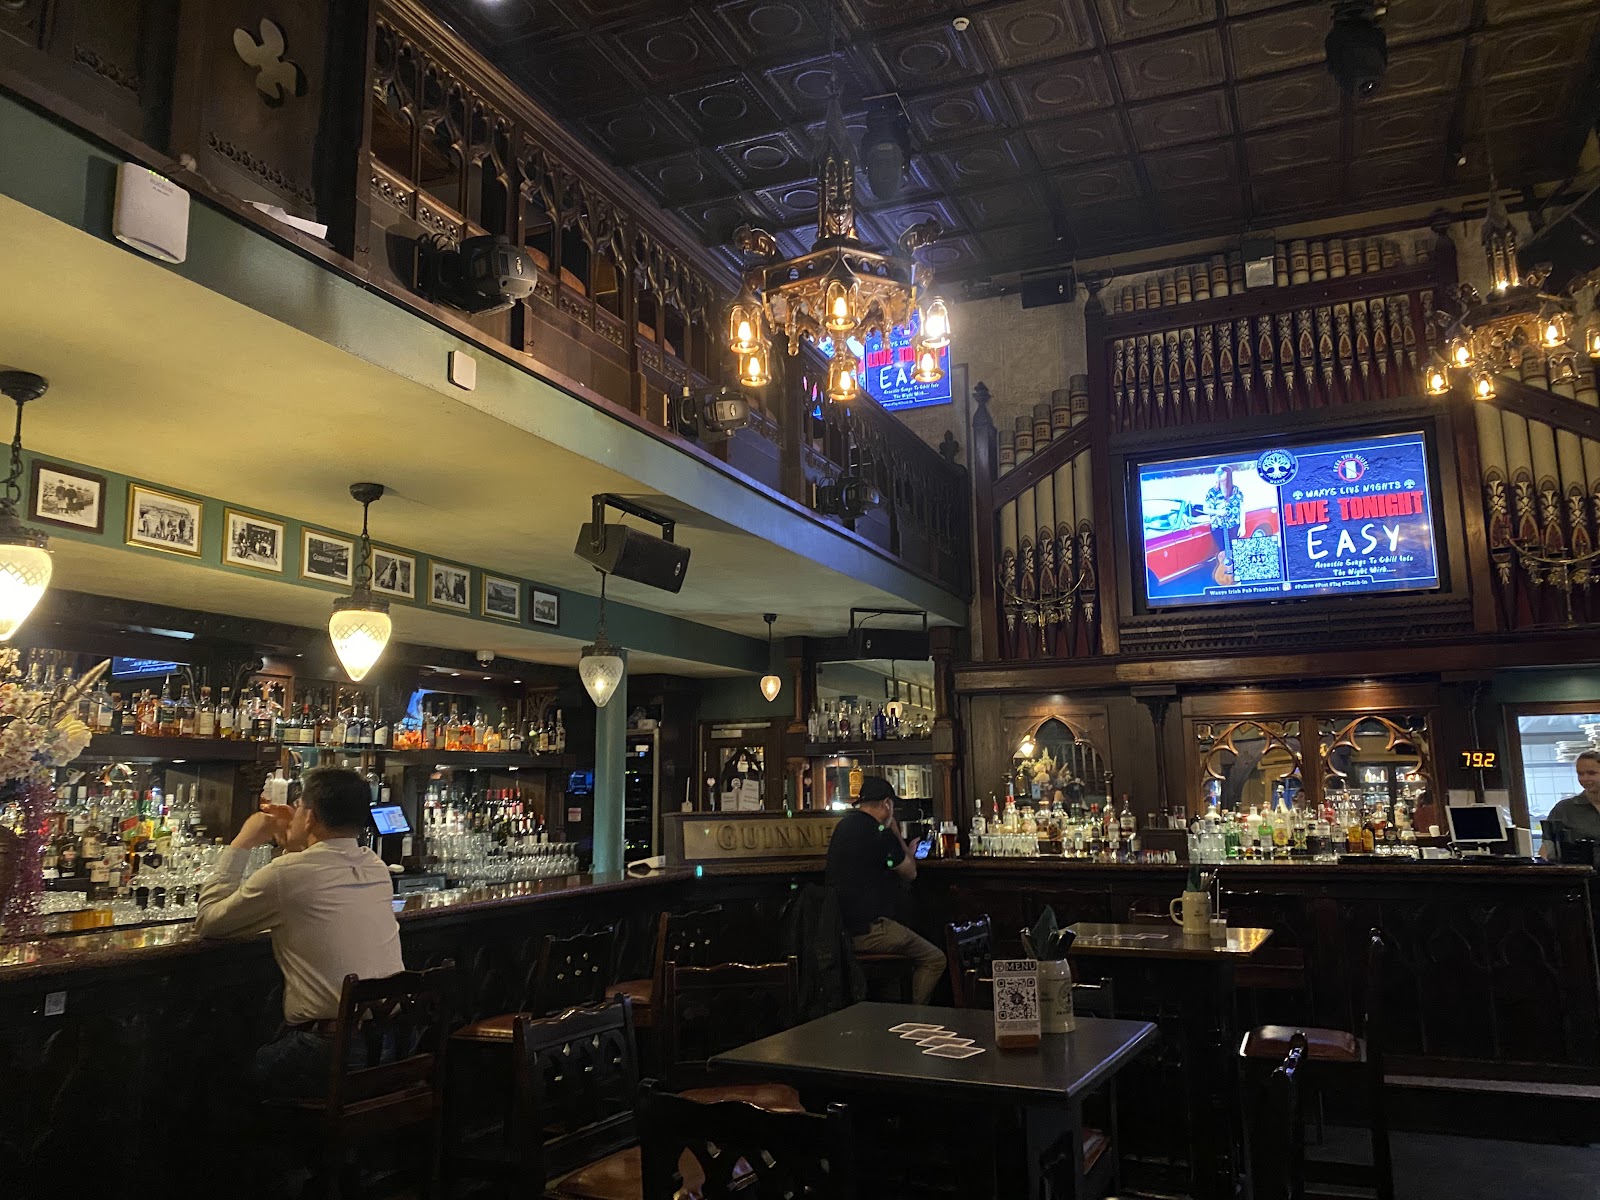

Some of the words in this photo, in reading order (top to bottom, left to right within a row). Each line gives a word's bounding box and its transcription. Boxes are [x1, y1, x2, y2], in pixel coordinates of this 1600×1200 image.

[868, 349, 893, 368] LIVE
[1355, 454, 1370, 470] MUSIC
[1306, 488, 1337, 498] WAXYS
[1363, 481, 1401, 492] NIGHTS
[1284, 500, 1329, 526] LIVE
[1337, 491, 1424, 520] TONIGHT
[1307, 523, 1400, 559] EASY
[716, 825, 832, 850] GUINNE
[1006, 962, 1036, 971] MENU
